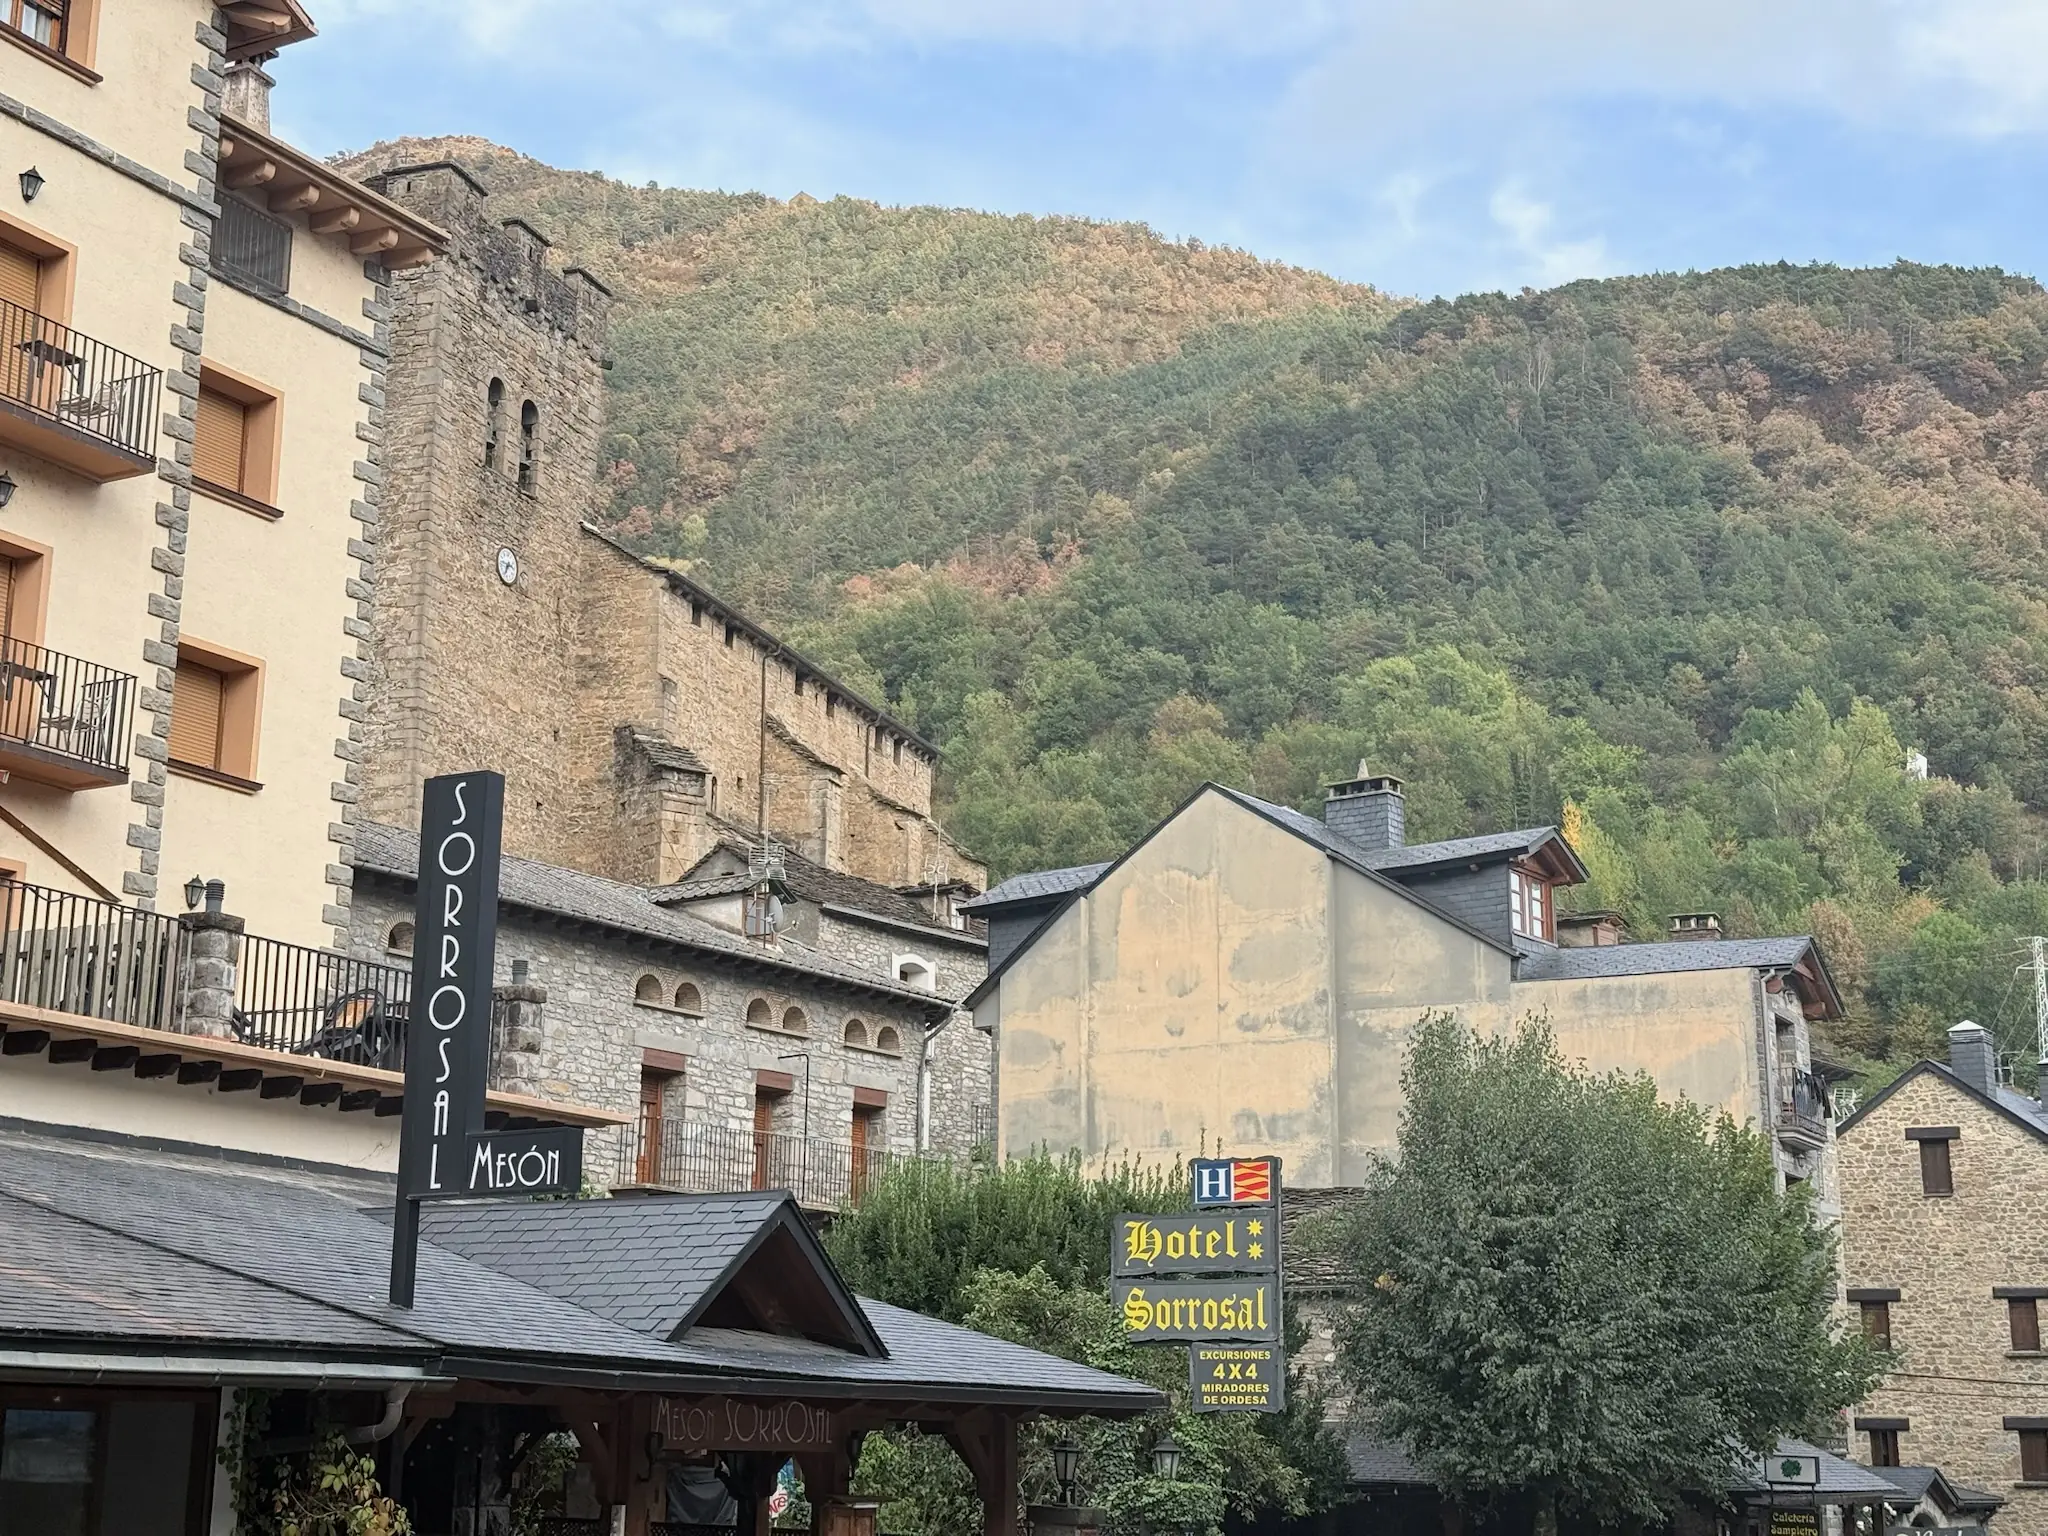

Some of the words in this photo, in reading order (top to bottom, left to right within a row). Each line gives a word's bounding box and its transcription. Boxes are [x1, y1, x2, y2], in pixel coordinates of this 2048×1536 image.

[429, 781, 476, 1190] SORROSAL
[1199, 1167, 1229, 1198] H
[1123, 1220, 1240, 1267] Hotel
[1123, 1287, 1268, 1332] Sorrosal
[1200, 1350, 1271, 1361] EXCURSIONES
[1201, 1383, 1270, 1393] MIRADORES
[1203, 1395, 1220, 1405] DE
[1222, 1395, 1268, 1405] ORDESA
